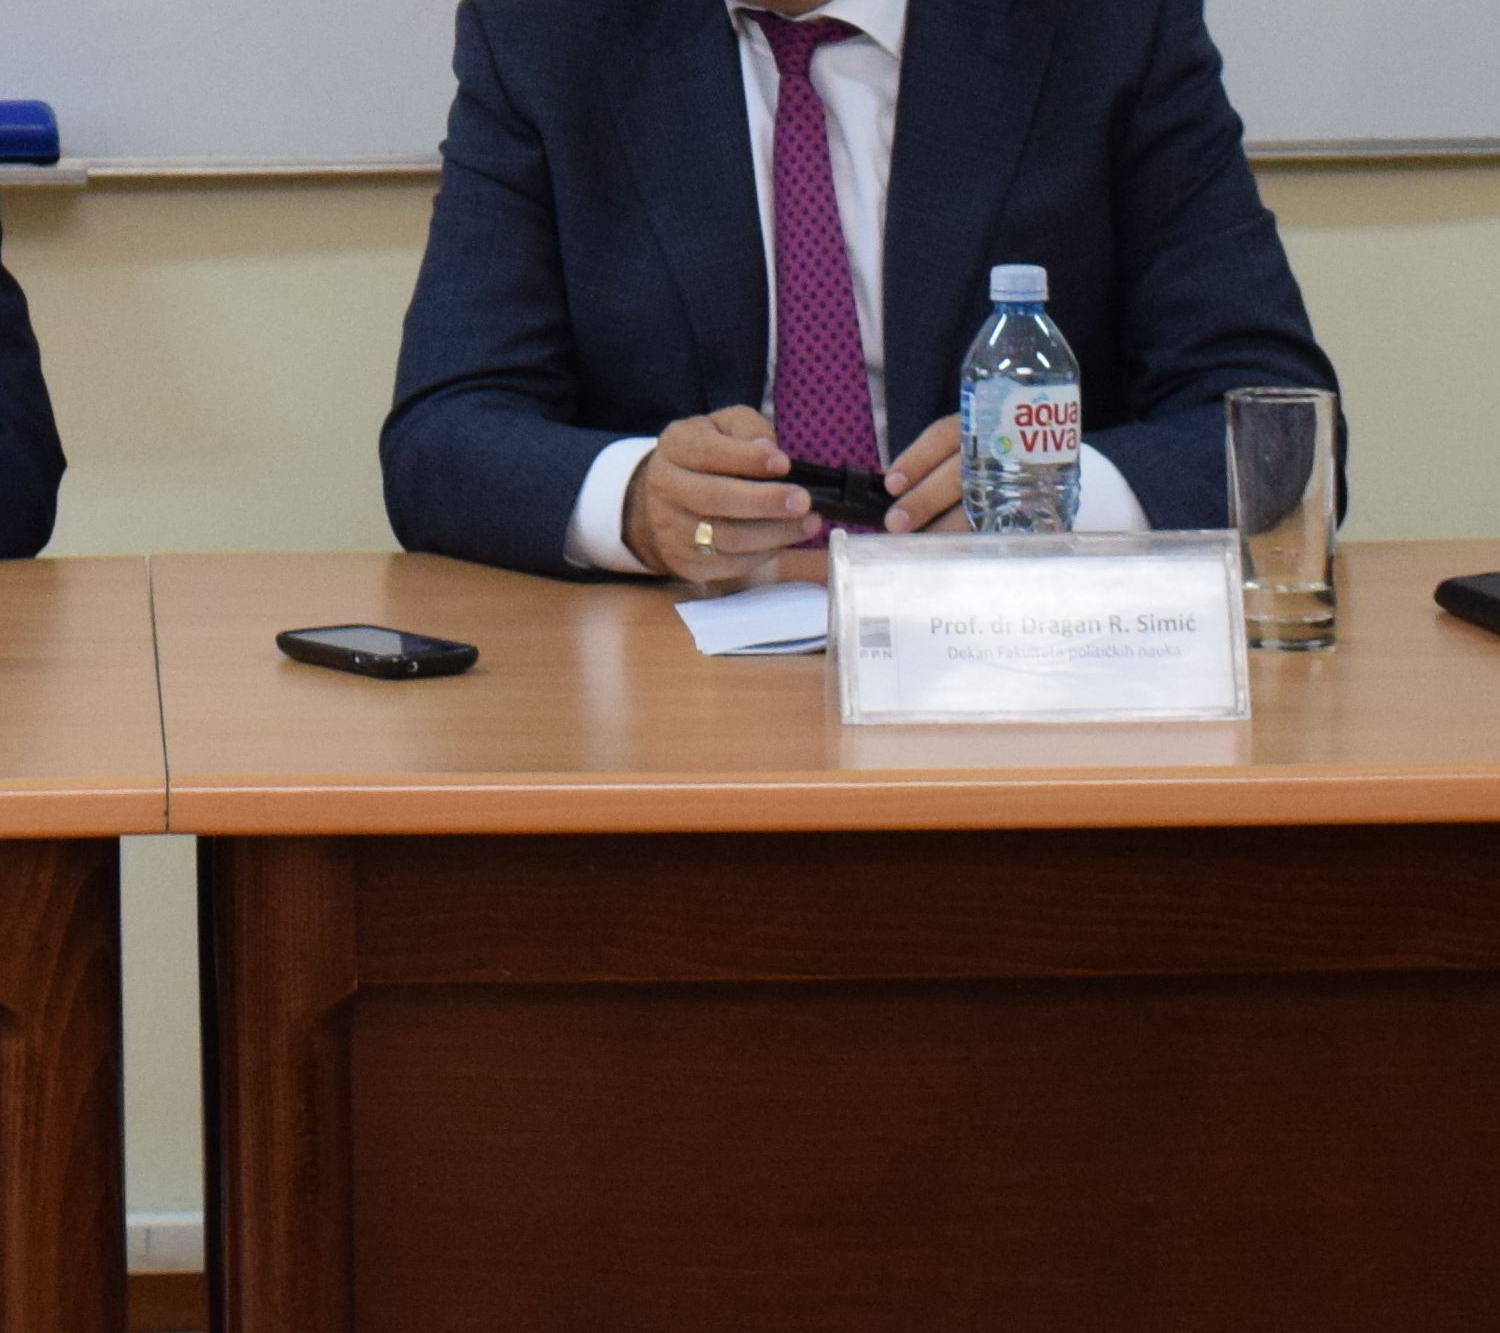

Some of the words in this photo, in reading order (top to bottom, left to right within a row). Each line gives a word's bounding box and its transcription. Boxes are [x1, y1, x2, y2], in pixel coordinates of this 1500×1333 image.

[1014, 401, 1079, 427] aqua
[1019, 428, 1078, 453] viva
[930, 616, 984, 635] Prof.
[991, 616, 1011, 634] dr
[1021, 616, 1101, 637] Dragan
[1108, 614, 1130, 634] R.
[1136, 612, 1197, 633] Simić
[948, 645, 994, 660] Dekan
[1138, 643, 1182, 658] nauka
